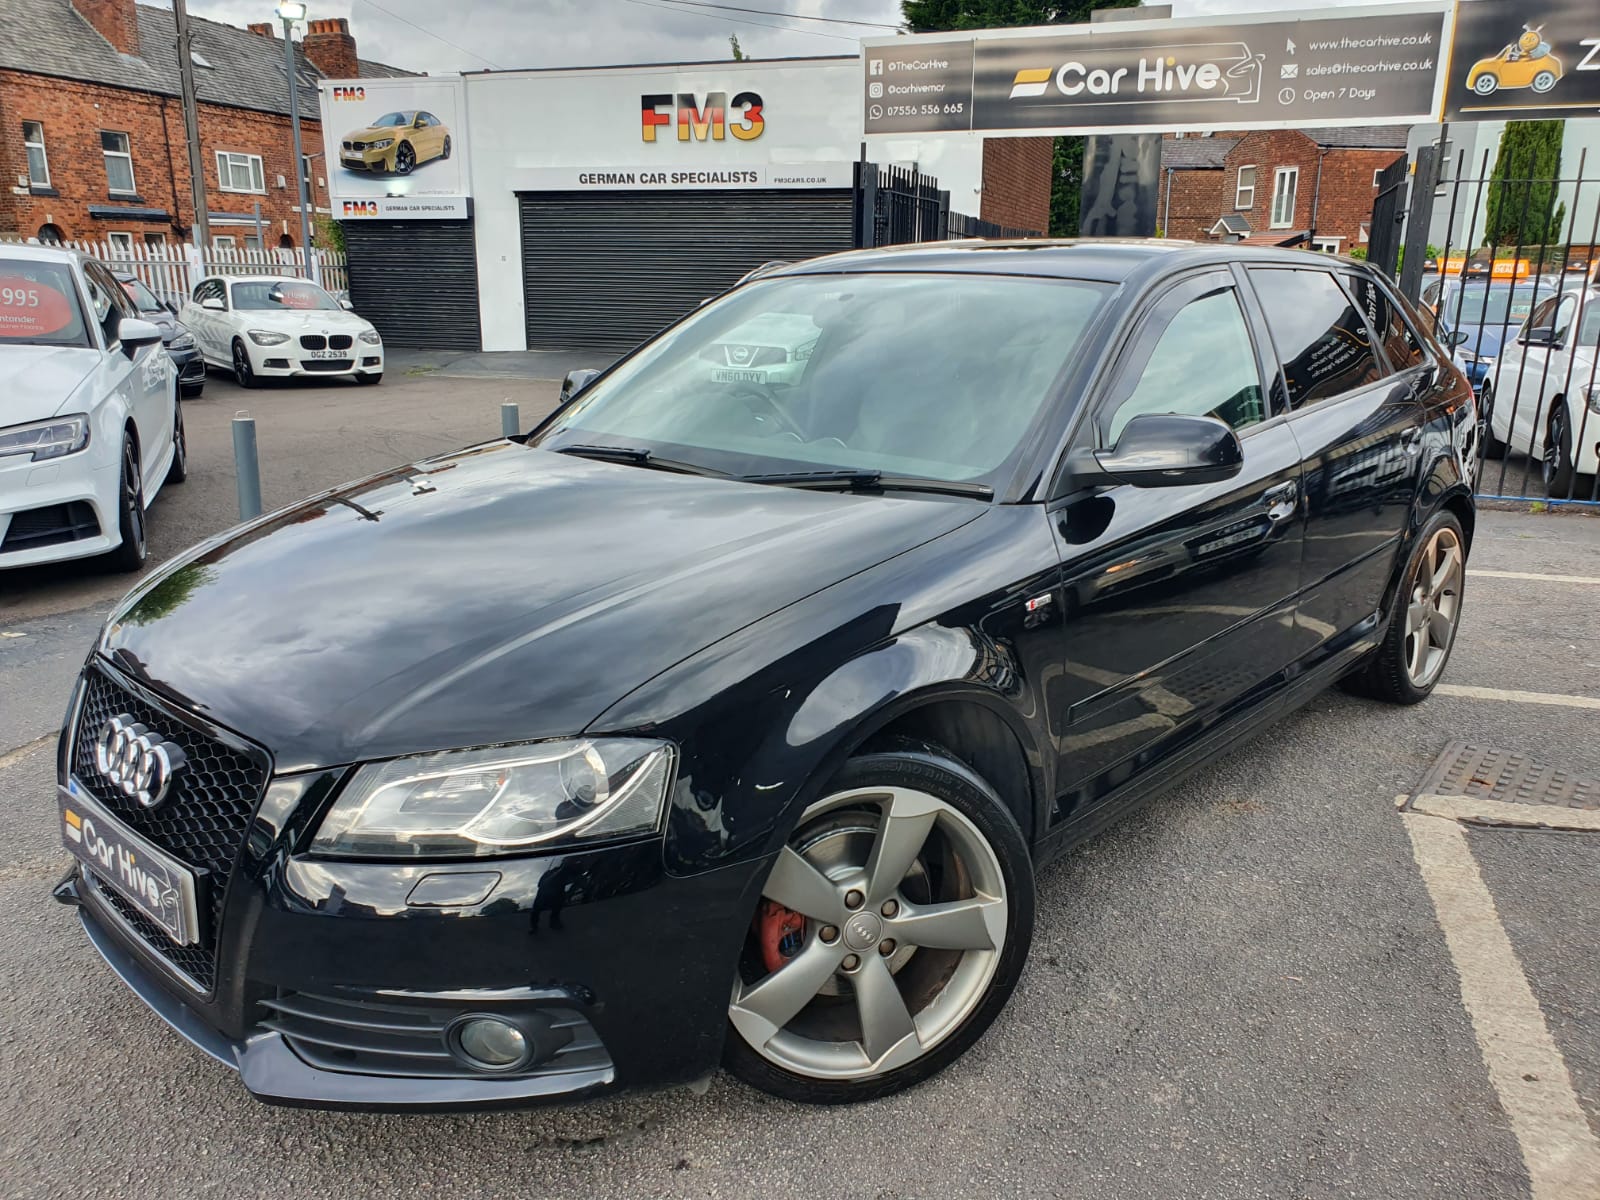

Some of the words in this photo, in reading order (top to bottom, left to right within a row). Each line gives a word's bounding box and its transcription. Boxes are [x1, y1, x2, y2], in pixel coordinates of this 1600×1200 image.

[1309, 32, 1432, 51] www.thecarhive.co.uk
[1305, 58, 1433, 76] sales@thecarhive.co.uk
[1056, 61, 1128, 96] Car
[1137, 56, 1221, 93] Hive
[333, 87, 366, 101] FM3
[887, 83, 945, 94] @carhivemcr
[1303, 88, 1335, 102] Open
[1338, 87, 1346, 98] 7
[1349, 87, 1376, 101] Days
[641, 91, 765, 143] FM3
[887, 106, 917, 116] 07556
[921, 104, 940, 114] 556
[943, 103, 963, 114] 665
[579, 173, 635, 185] GERMAN
[639, 172, 667, 184] CAR
[671, 171, 758, 184] SPECIALISTS
[342, 201, 378, 216] FM3
[421, 204, 455, 212] SPECIALISTS
[0, 287, 39, 308] 995
[83, 818, 115, 871] Car
[117, 843, 160, 907] Hive
